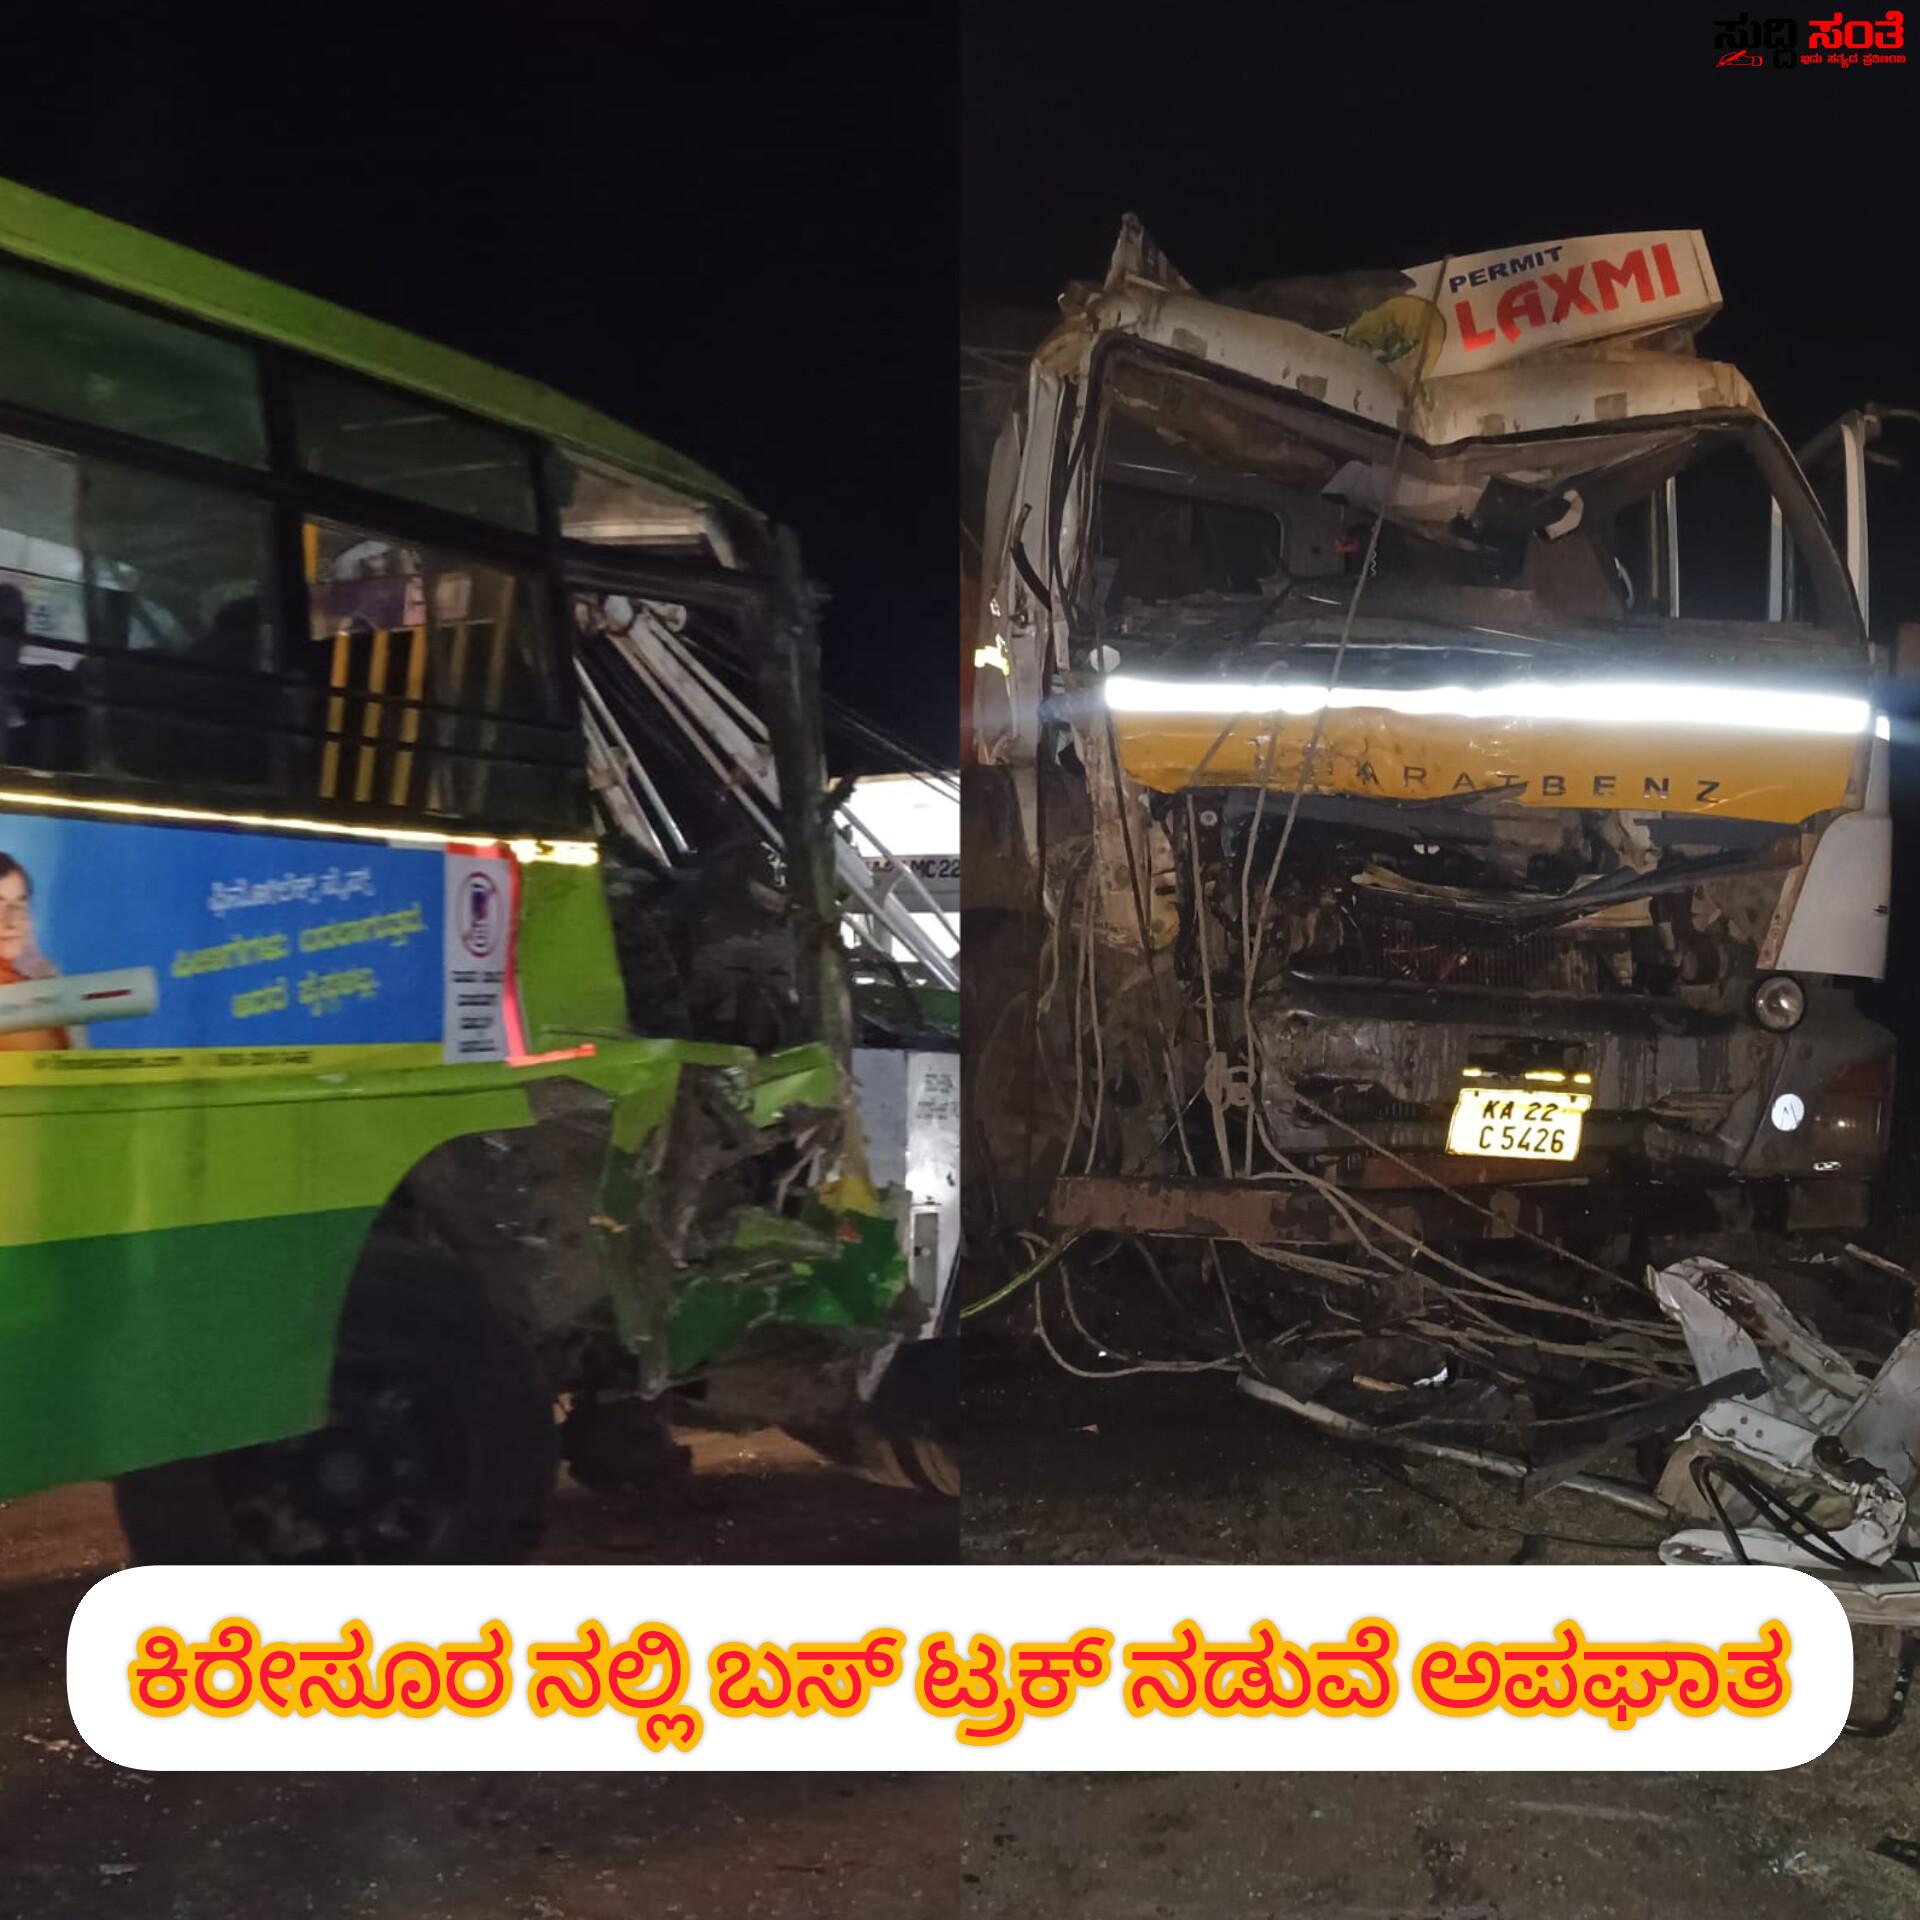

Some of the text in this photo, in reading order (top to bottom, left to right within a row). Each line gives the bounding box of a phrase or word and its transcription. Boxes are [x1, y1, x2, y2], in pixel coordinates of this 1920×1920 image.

[1448, 245, 1564, 294] PERMIT
[1453, 242, 1682, 354] LAXMI
[1482, 1099, 1560, 1122] KA 22
[1478, 1125, 1566, 1154] C 5426
